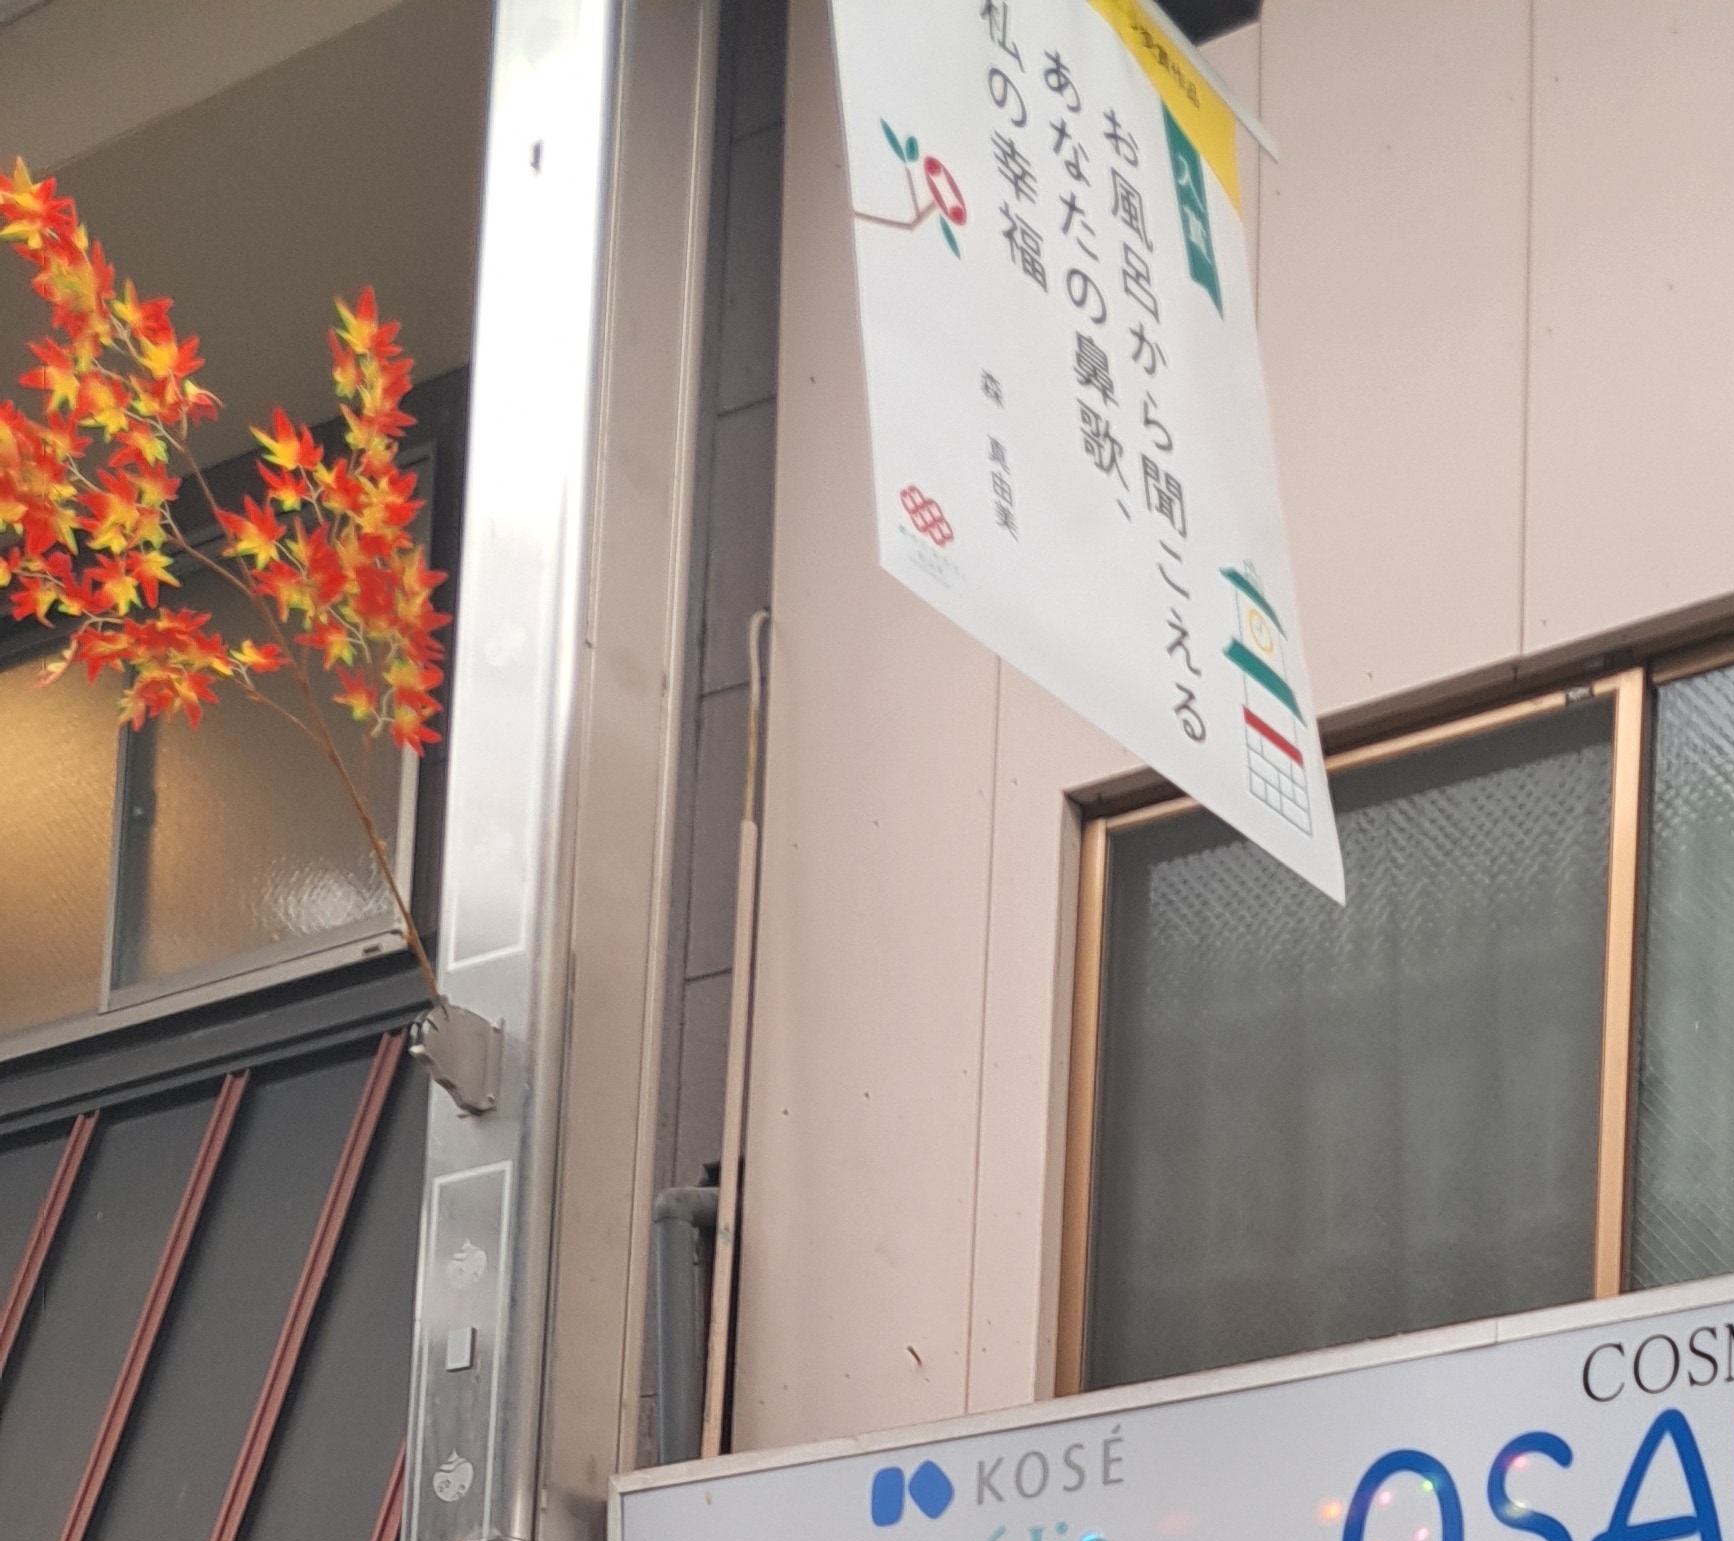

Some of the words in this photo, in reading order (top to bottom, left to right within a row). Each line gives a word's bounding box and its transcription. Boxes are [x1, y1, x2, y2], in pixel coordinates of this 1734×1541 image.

[1040, 46, 1133, 523] あなたの鼻歌、
[1103, 106, 1207, 744] お風呂から聞こえる
[976, 1424, 1126, 1506] KOSÉ
